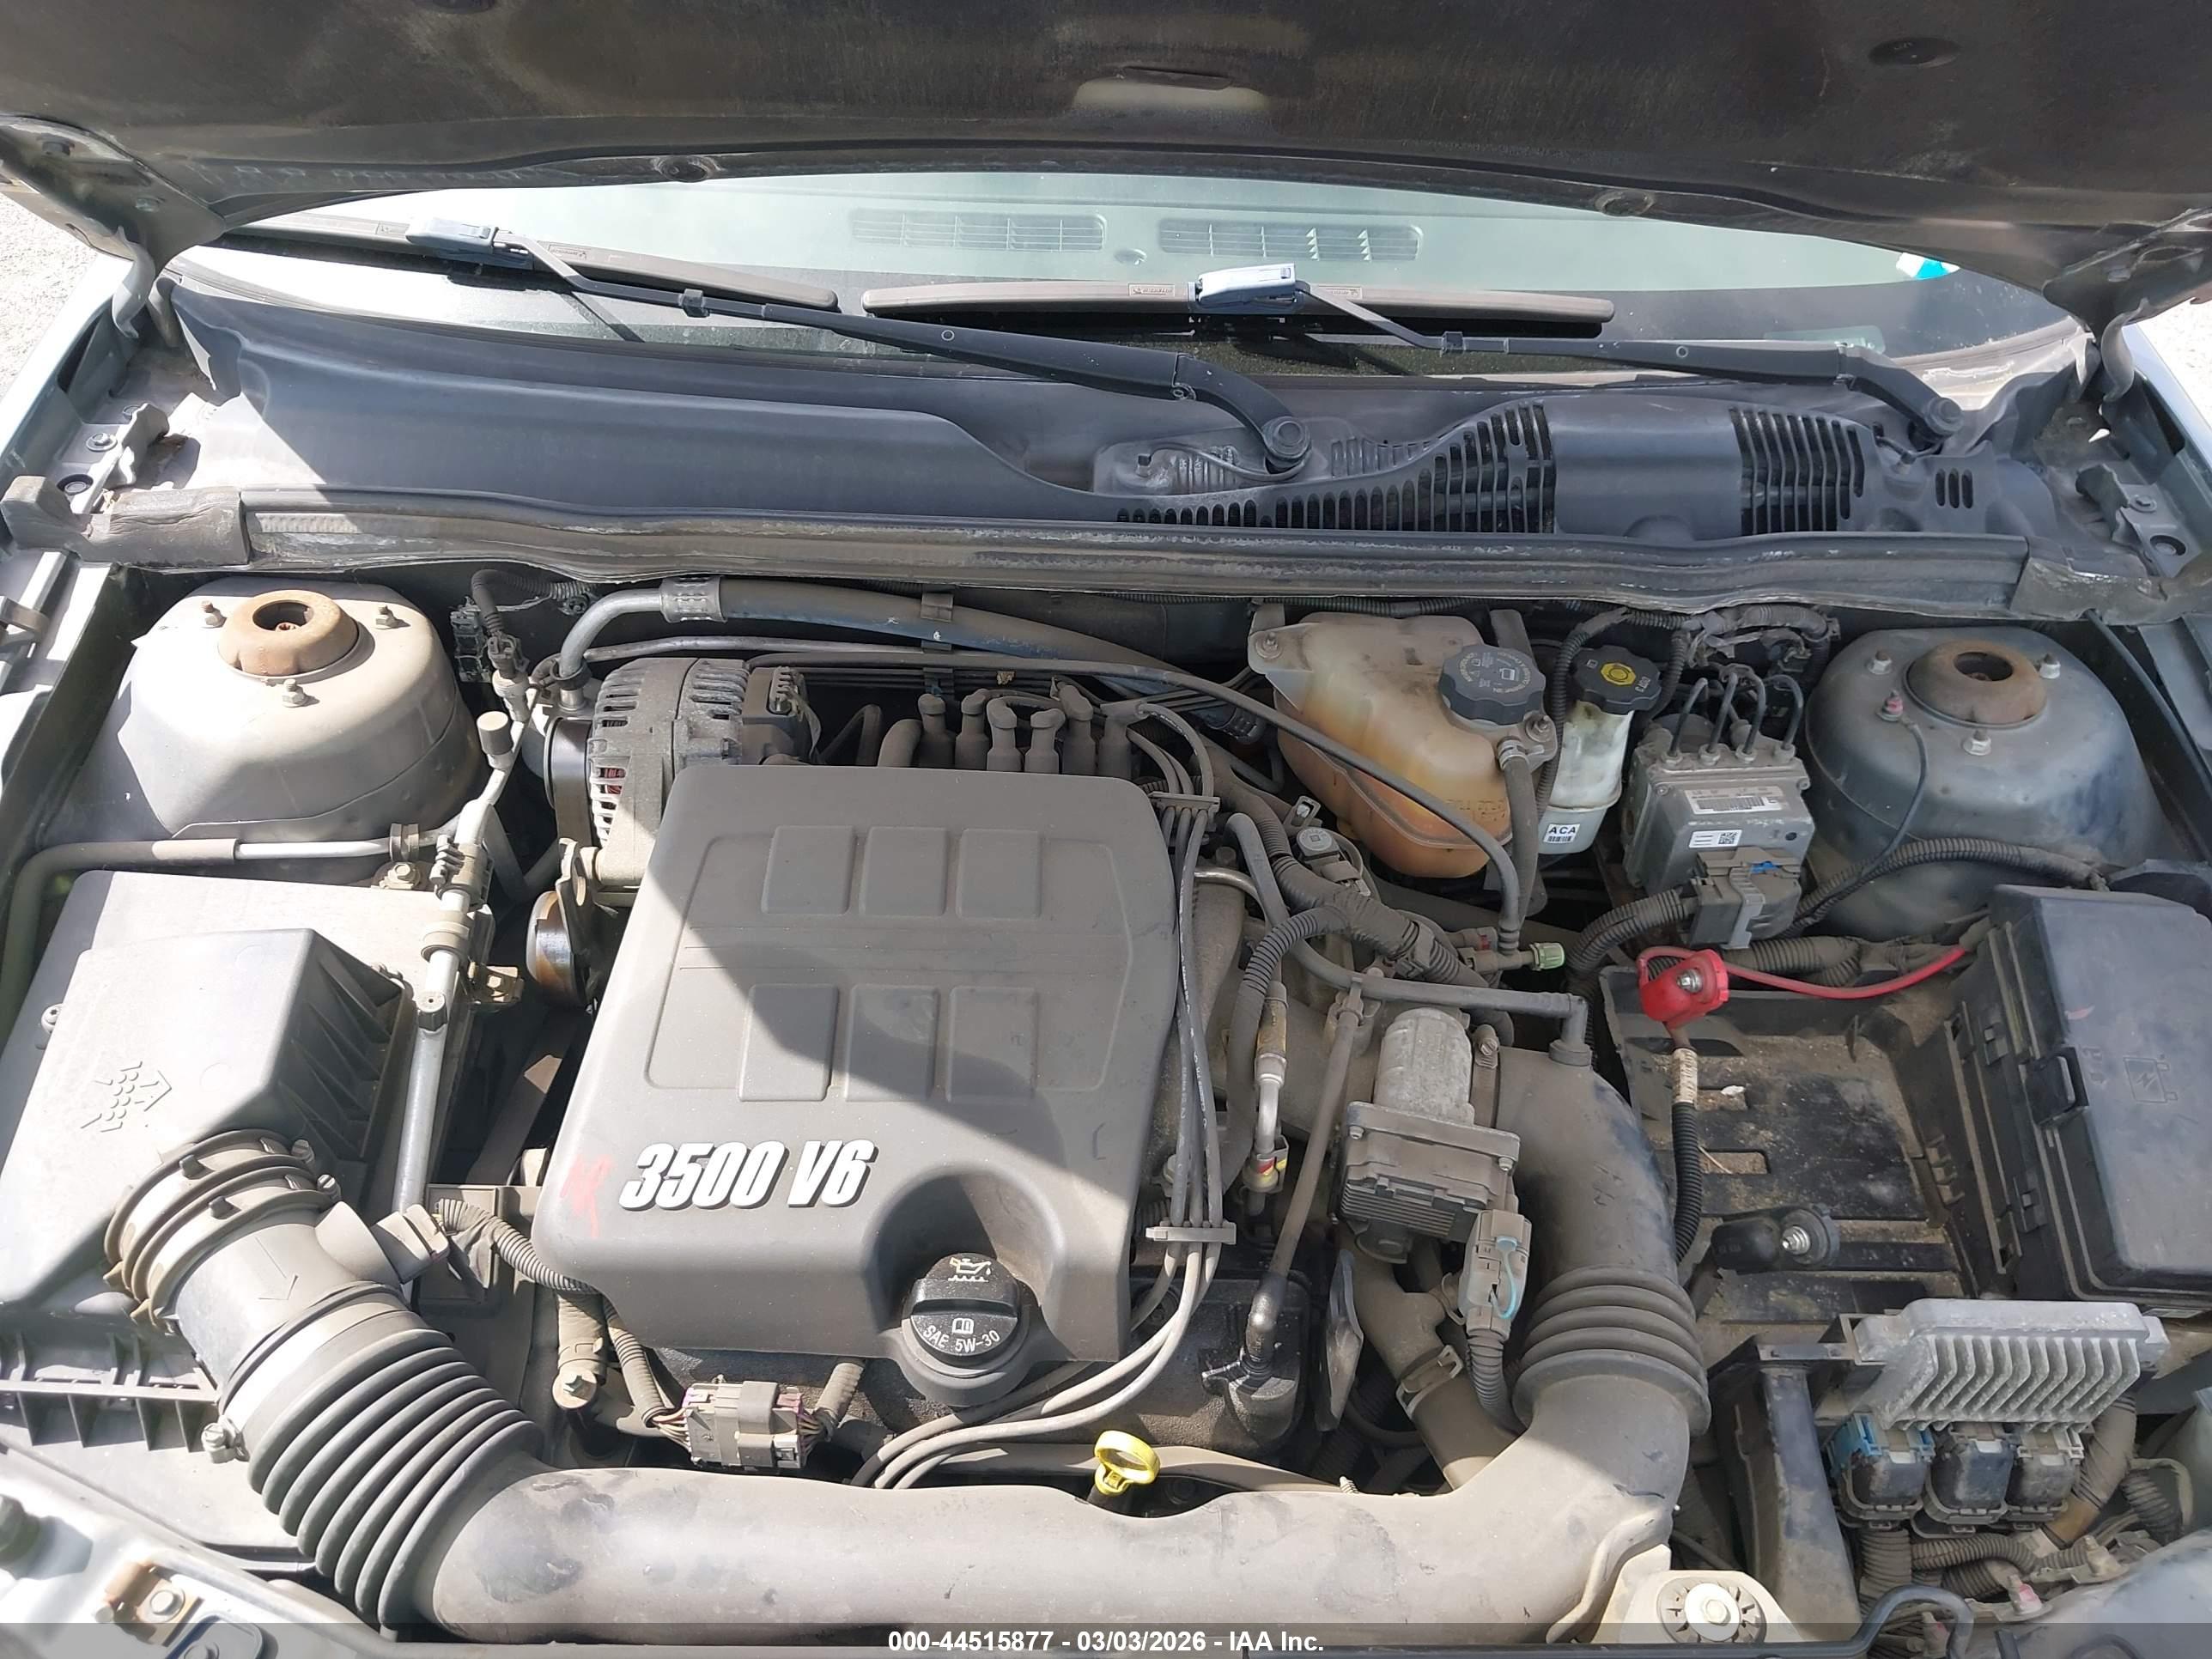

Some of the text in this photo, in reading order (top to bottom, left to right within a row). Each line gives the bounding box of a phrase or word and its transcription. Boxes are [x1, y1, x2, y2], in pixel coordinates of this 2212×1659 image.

[618, 1139, 878, 1210] 3500 V6
[923, 1325, 1000, 1352] SAE 5W-30
